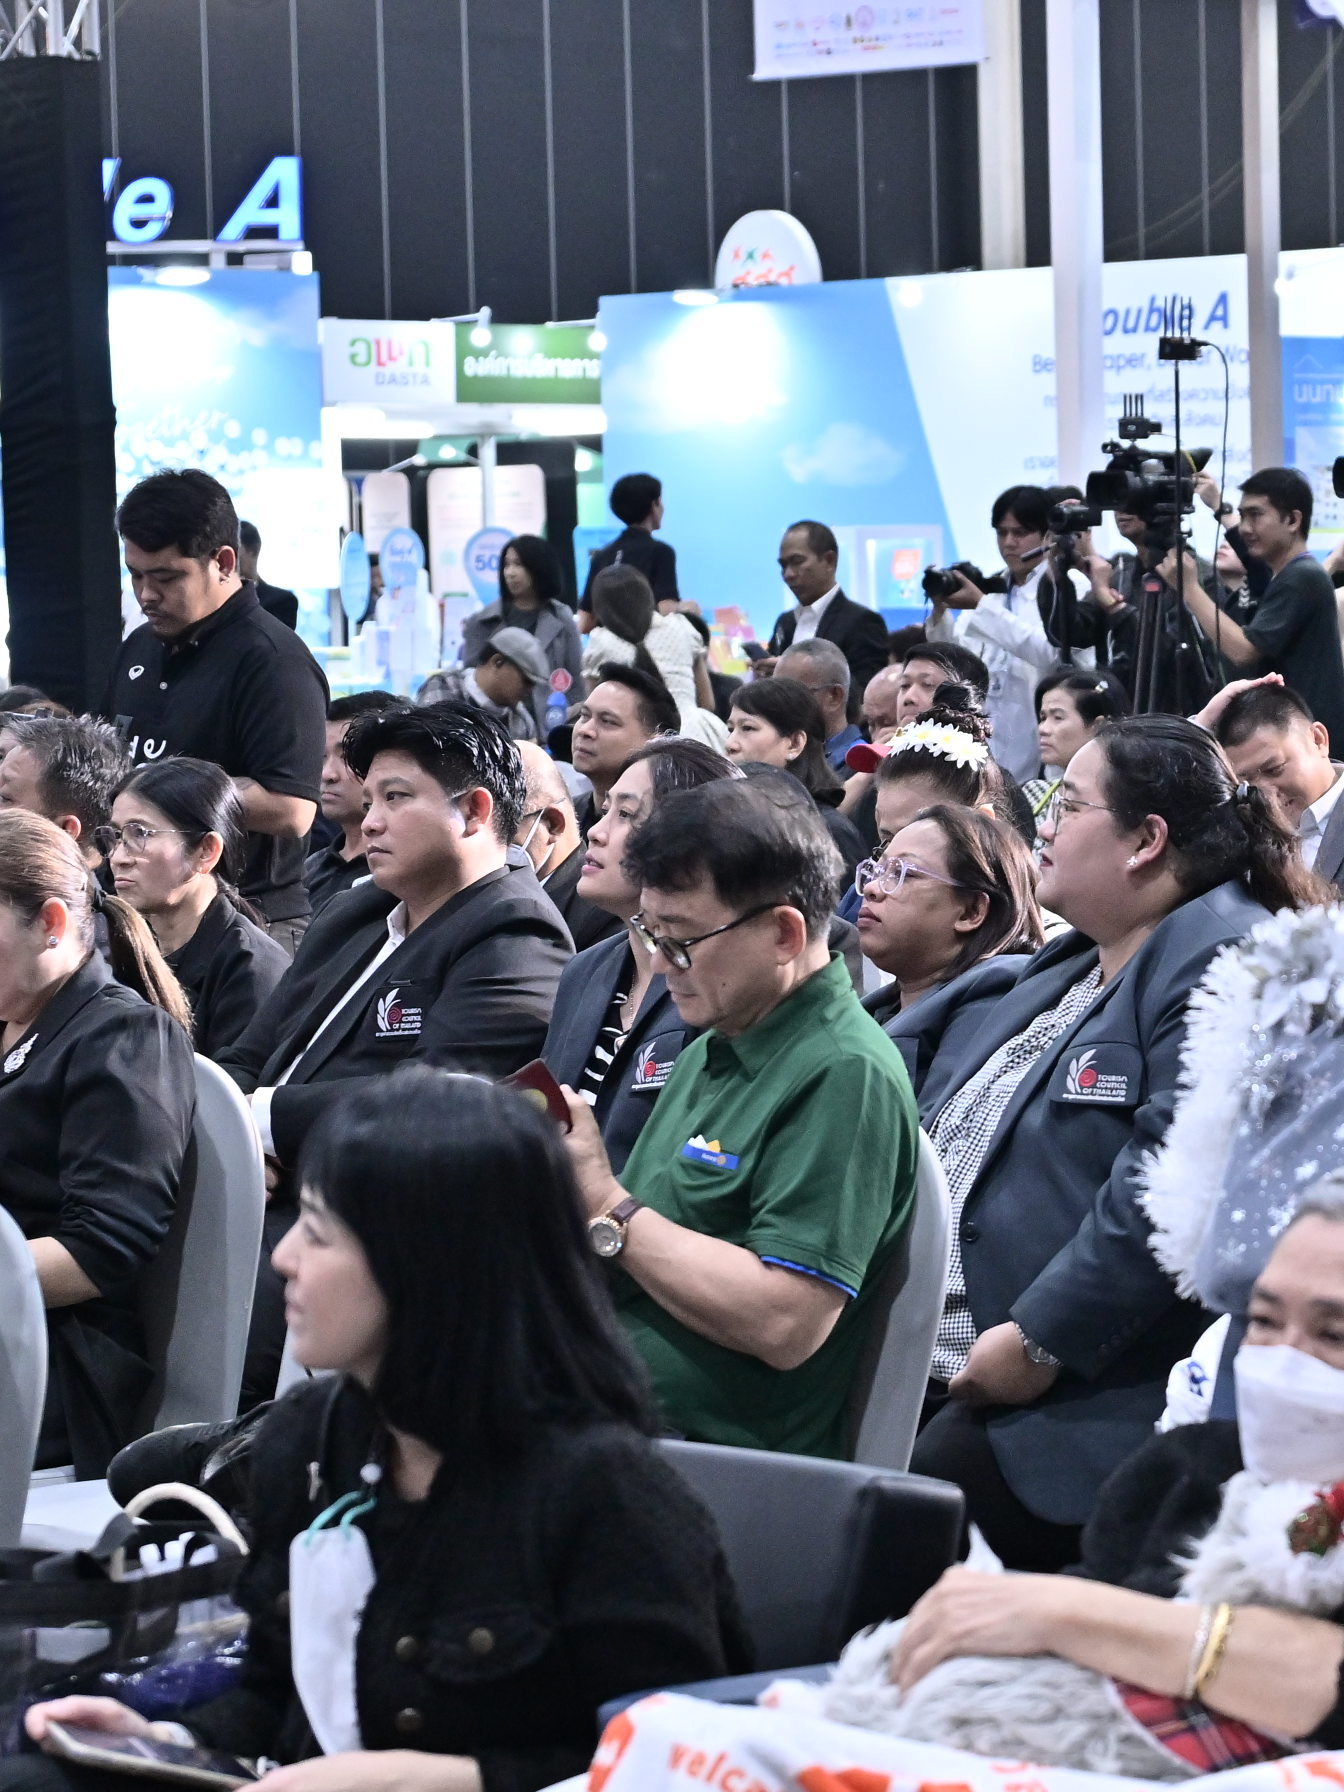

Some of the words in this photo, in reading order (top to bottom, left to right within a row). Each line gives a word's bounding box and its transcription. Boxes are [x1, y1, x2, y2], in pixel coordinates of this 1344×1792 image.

[102, 156, 174, 246] e
[214, 155, 303, 244] A
[1102, 294, 1194, 336] ouble
[1203, 291, 1230, 331] A
[1102, 350, 1152, 376] aper,
